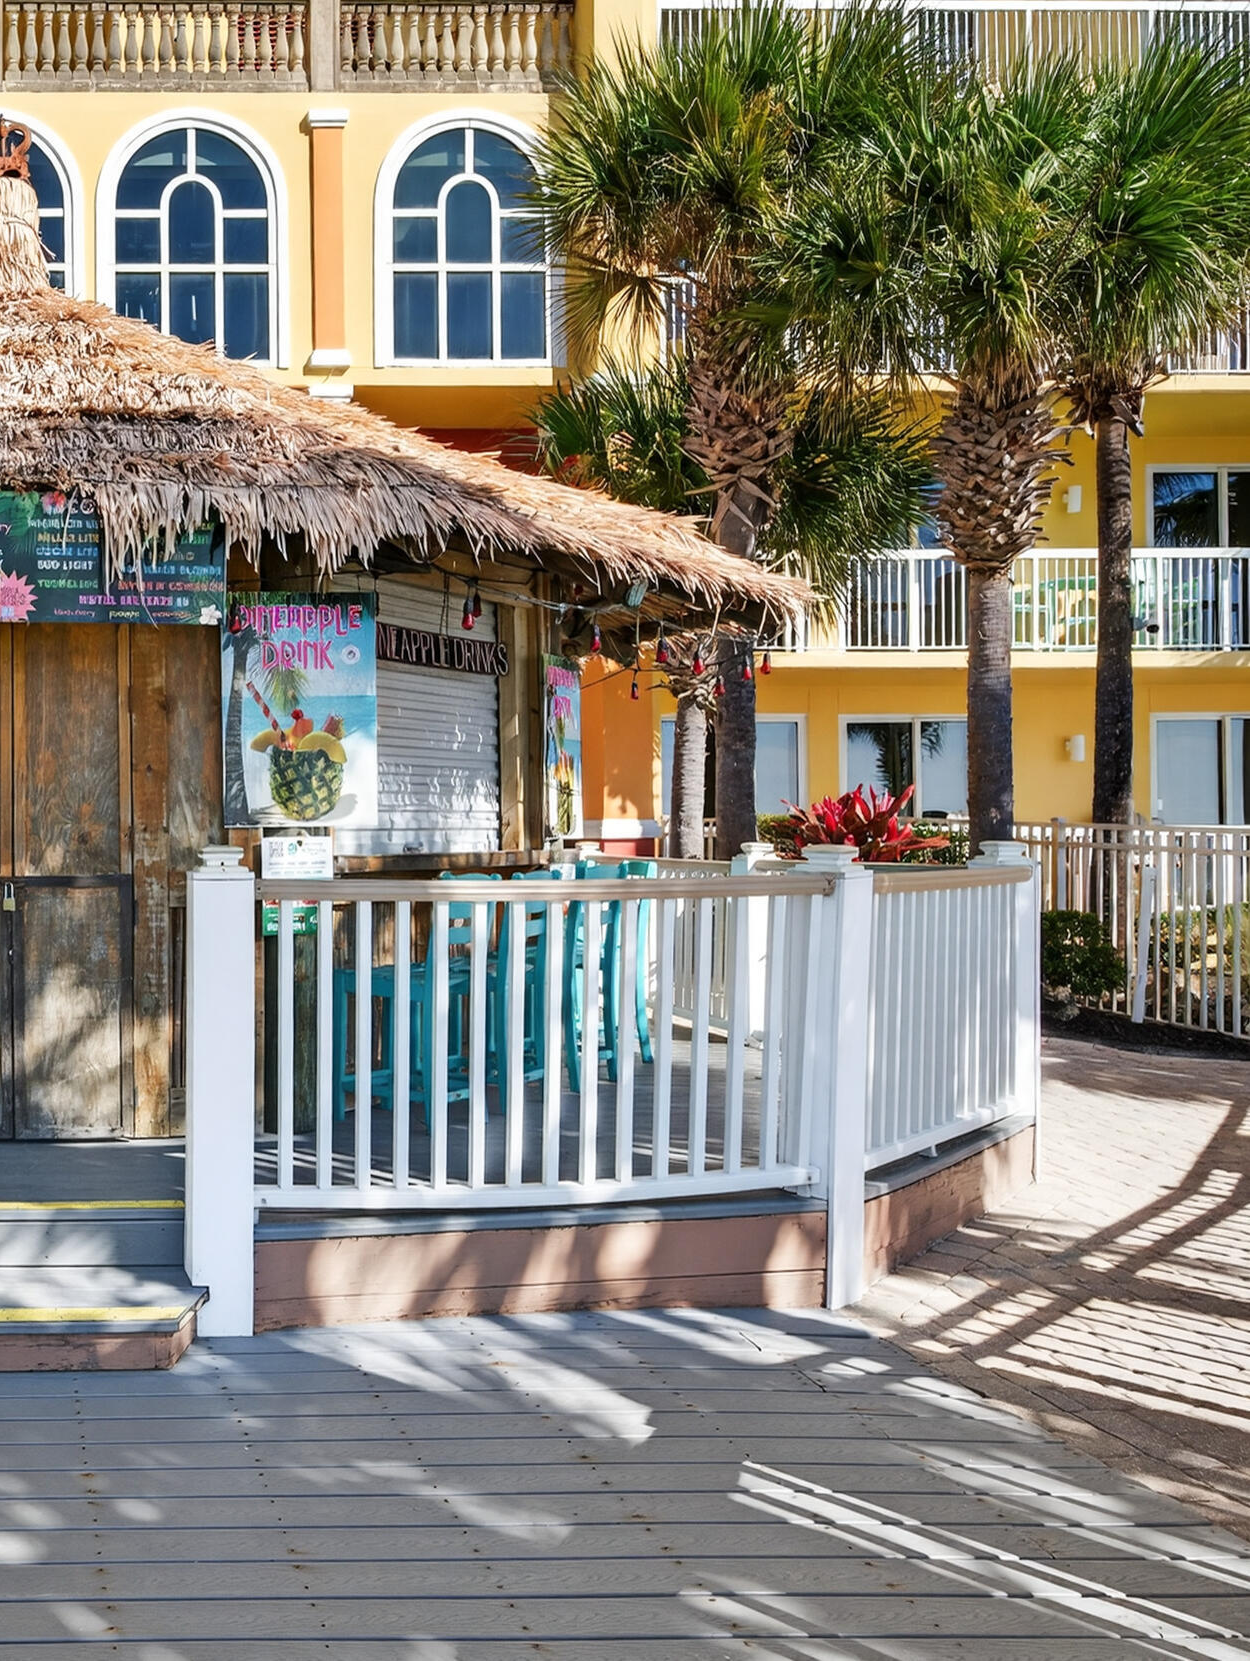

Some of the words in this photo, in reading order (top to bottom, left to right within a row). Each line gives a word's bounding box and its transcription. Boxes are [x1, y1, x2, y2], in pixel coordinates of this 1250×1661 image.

[37, 559, 60, 570] BUD
[62, 559, 94, 570] LIGHT
[261, 638, 335, 671] DRINK
[377, 623, 451, 668] NEAPPLE
[453, 638, 509, 677] DRINKS
